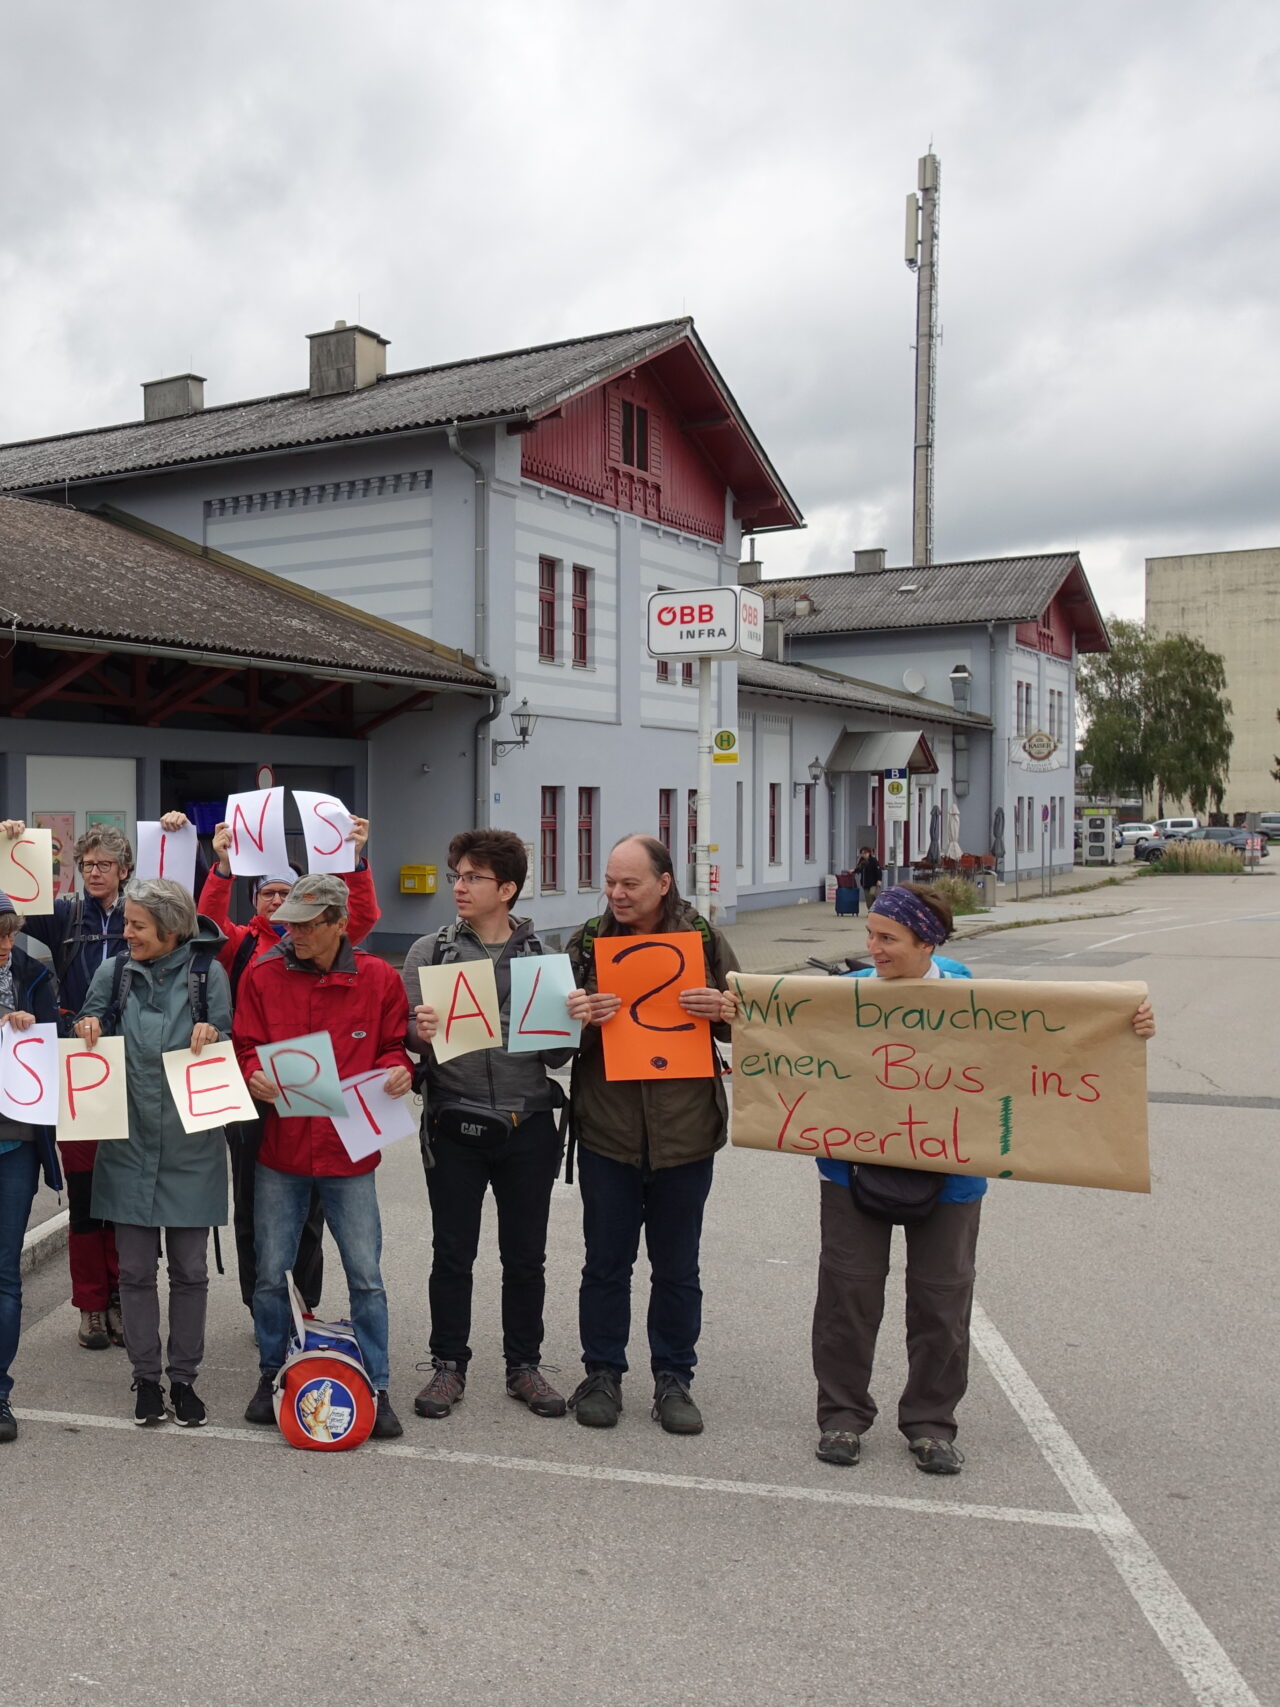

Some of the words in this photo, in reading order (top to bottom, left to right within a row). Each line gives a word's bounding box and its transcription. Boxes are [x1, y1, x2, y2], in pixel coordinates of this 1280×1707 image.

[657, 604, 714, 626] ÖBB
[741, 603, 759, 627] ÖBB
[679, 628, 727, 640] INFRA
[891, 769, 900, 779] B
[734, 977, 812, 1030] Wir
[855, 979, 1065, 1033] brauchen
[740, 1051, 851, 1080] einen
[872, 1043, 985, 1095] Bus
[1030, 1064, 1102, 1103] ins
[460, 1122, 483, 1136] CAT
